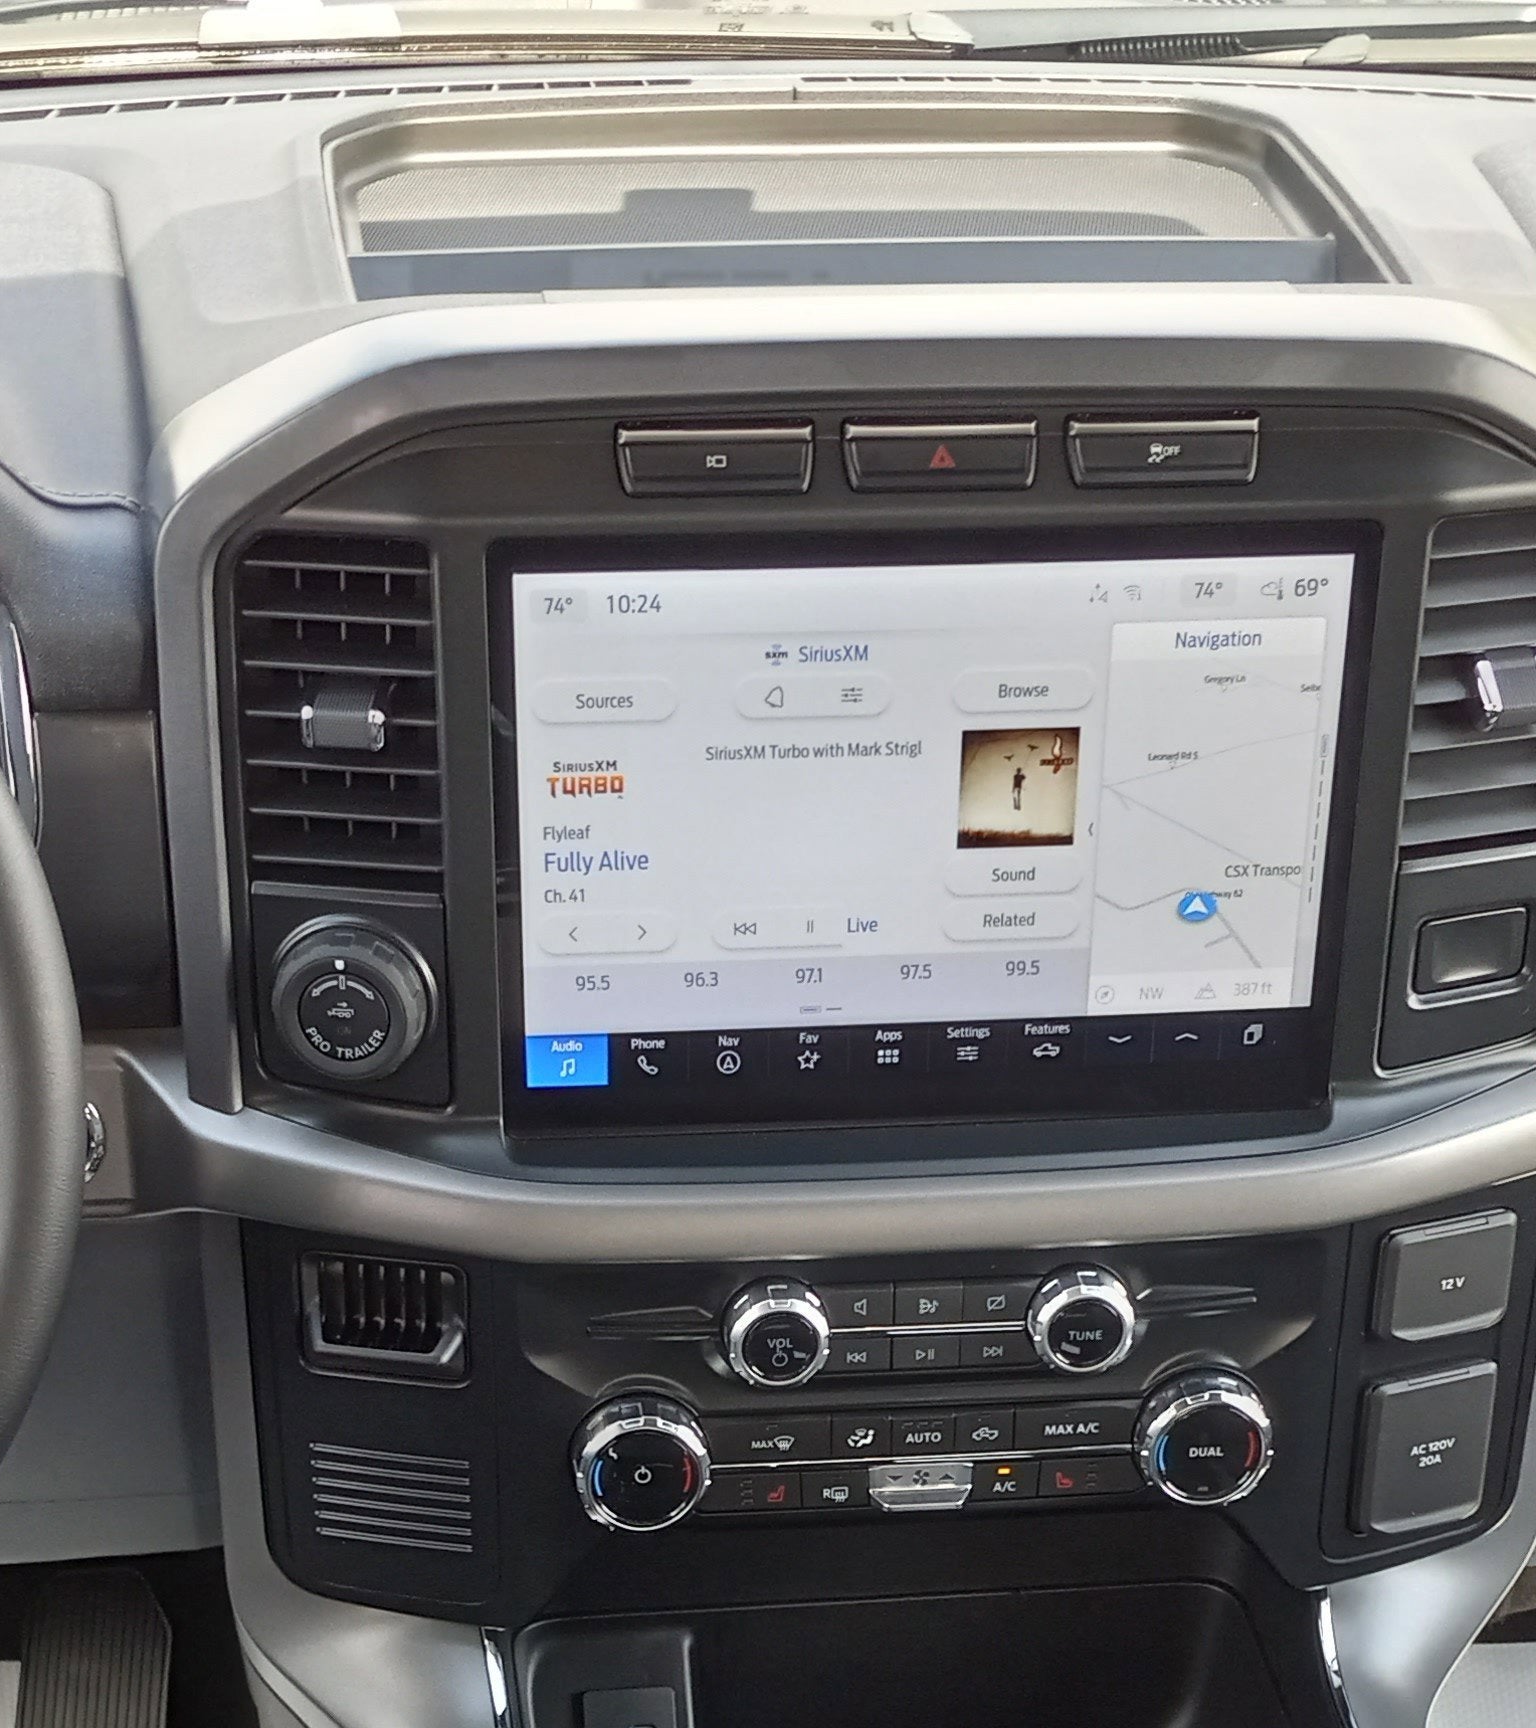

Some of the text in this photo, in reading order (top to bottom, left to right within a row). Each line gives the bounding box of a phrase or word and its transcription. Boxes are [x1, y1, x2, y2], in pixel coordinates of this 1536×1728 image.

[1163, 445, 1181, 458] OFF
[1194, 581, 1223, 599] 74°
[1294, 577, 1329, 597] 69°
[544, 597, 573, 615] 74°
[606, 594, 662, 614] 10:24
[1175, 631, 1262, 650] Navigation
[798, 644, 869, 663] SiriusXM
[998, 683, 1050, 699] Browse
[576, 693, 634, 710] Sources
[705, 740, 922, 762] SiriusXM Turbo with Mark Strigl
[546, 775, 624, 799] TURBO
[543, 825, 591, 842] Flyleaf
[544, 850, 649, 875] Fully Alive
[991, 867, 1036, 883] Sound
[1225, 864, 1301, 879] CSX Transpo
[544, 889, 586, 904] Ch. 41
[847, 917, 878, 933] Live
[983, 912, 1036, 928] Related
[900, 964, 932, 980] 97.5
[1005, 959, 1040, 976] 99.5
[575, 975, 610, 992] 95.5
[684, 971, 719, 988] 96.3
[796, 968, 823, 984] 97.1
[1139, 987, 1163, 1000] NW
[875, 1029, 903, 1044] Apps
[947, 1025, 991, 1040] Settings
[1024, 1023, 1070, 1037] Features
[306, 1026, 386, 1059] PRO TRAILER
[551, 1040, 583, 1053] Audio
[630, 1037, 666, 1051] Phone
[718, 1035, 740, 1048] Nav
[799, 1032, 819, 1045] Fav
[767, 1338, 793, 1350] VOL
[1068, 1330, 1103, 1342] TUNE
[1044, 1422, 1100, 1436] MAX A/C
[751, 1439, 775, 1450] MAX
[905, 1432, 942, 1444] AUTO
[1189, 1446, 1224, 1458] DUAL
[1410, 1443, 1428, 1457] AC
[993, 1481, 1016, 1493] A/C
